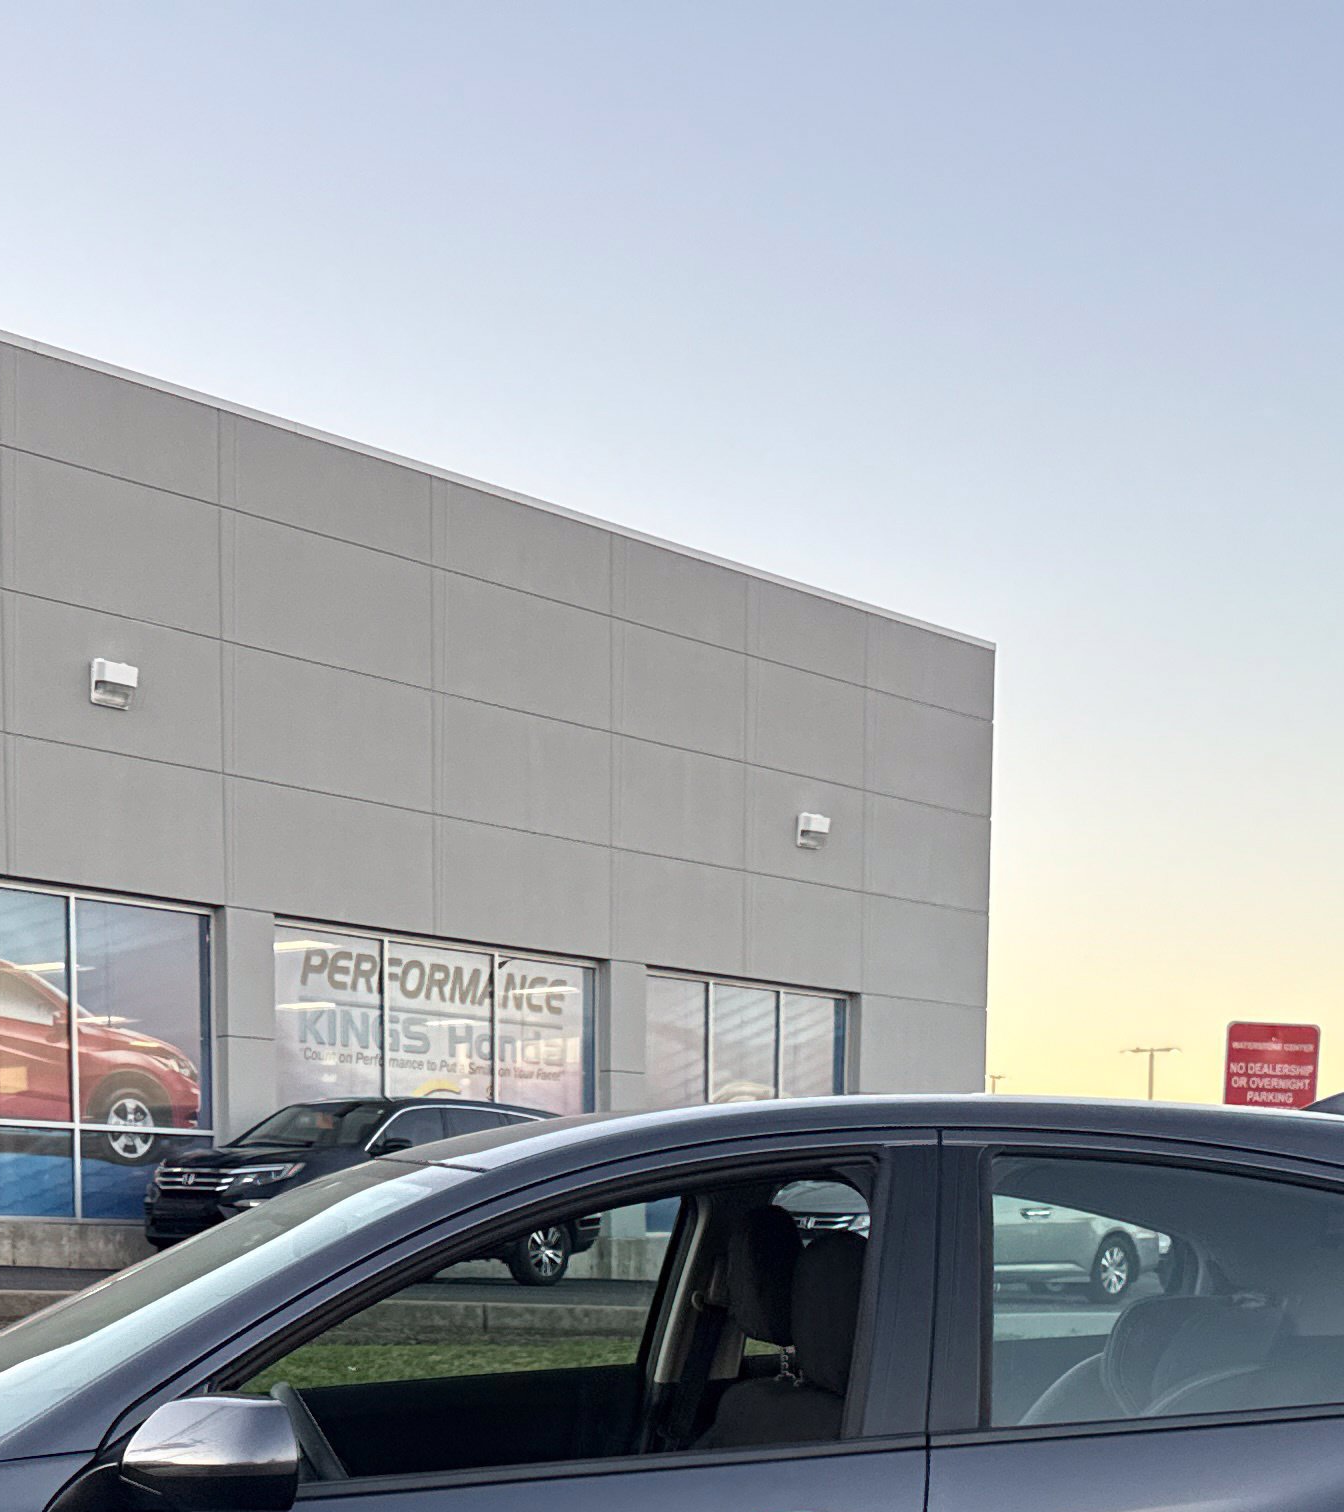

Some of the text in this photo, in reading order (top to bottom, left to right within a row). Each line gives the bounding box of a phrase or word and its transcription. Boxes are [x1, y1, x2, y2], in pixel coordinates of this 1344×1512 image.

[298, 1008, 566, 1066] KINGS Honda
[339, 1053, 353, 1064] on
[356, 1052, 424, 1070] Perfomance
[426, 1059, 438, 1071] to
[1230, 1062, 1314, 1076] NO DEALERSHIP
[1231, 1077, 1310, 1090] OR OVERNIGHT
[1247, 1091, 1293, 1103] PARKING
